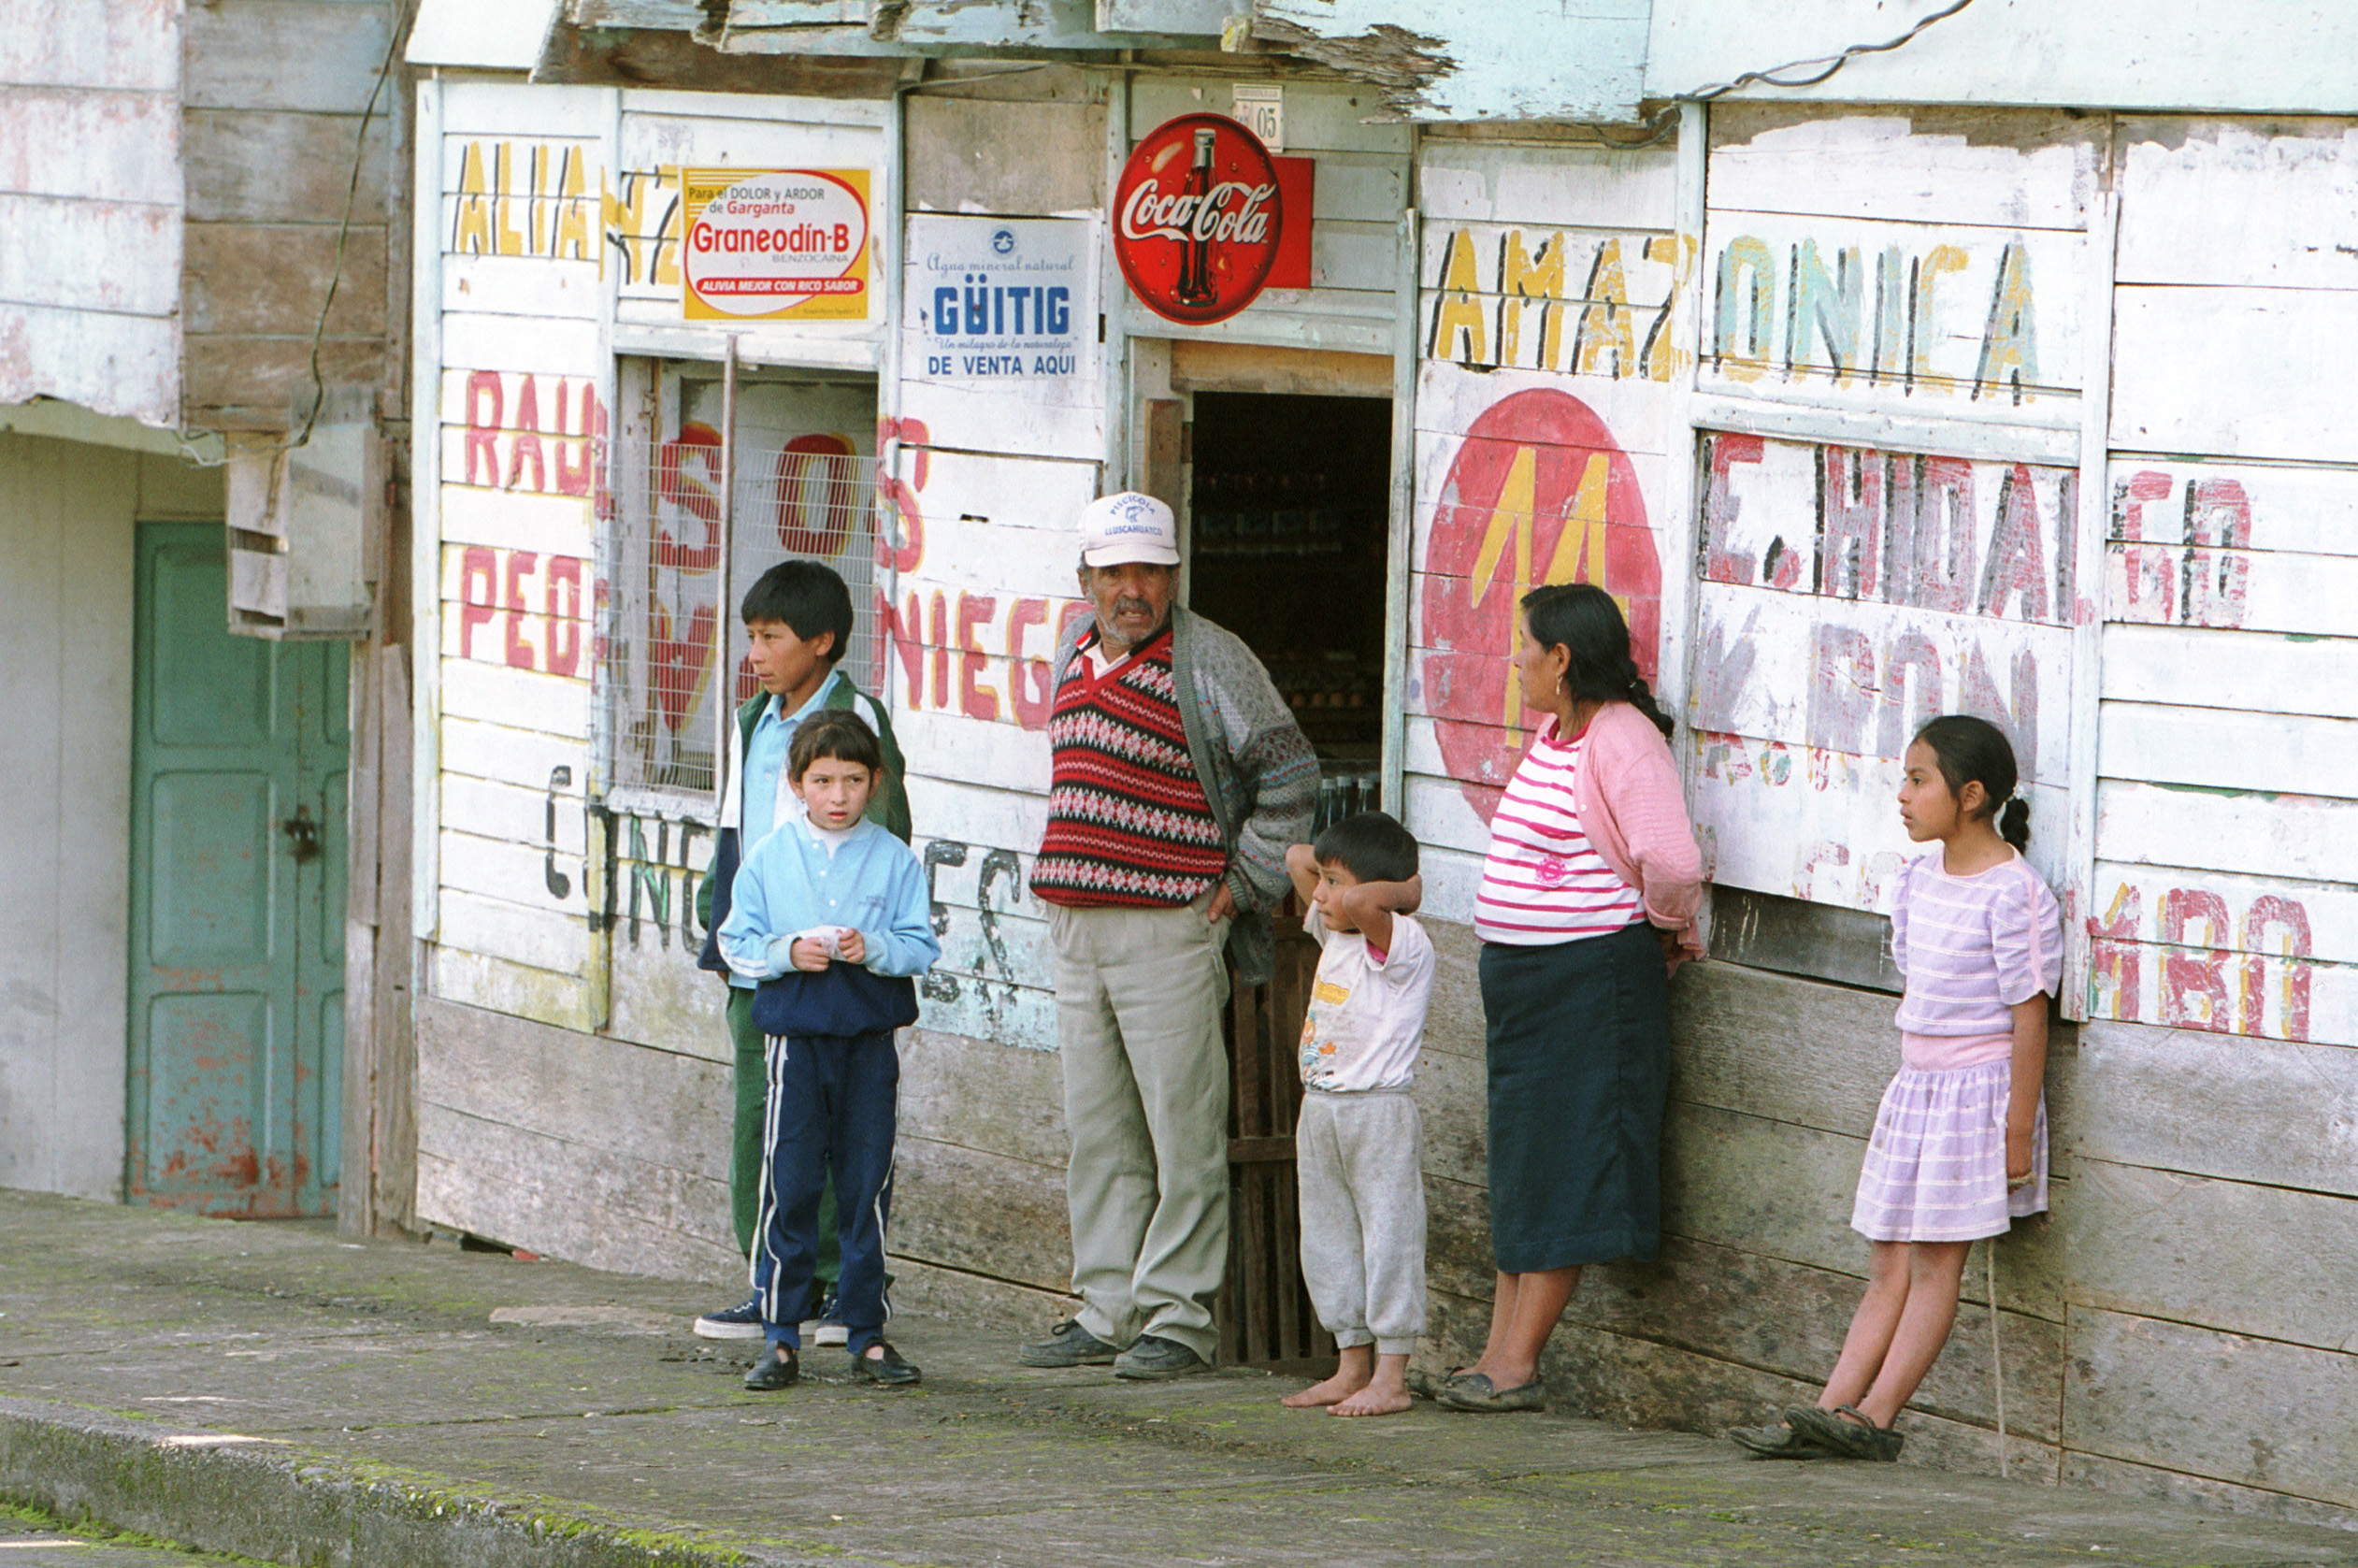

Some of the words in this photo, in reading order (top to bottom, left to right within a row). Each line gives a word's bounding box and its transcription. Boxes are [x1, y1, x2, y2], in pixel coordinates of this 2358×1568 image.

[689, 187, 713, 199] Para
[717, 187, 727, 199] el
[731, 188, 770, 199] DOLOR
[774, 191, 781, 202] y
[784, 188, 825, 199] ARDOR
[710, 202, 724, 213] de
[727, 201, 795, 217] Garganta
[1122, 179, 1276, 243] Coca-Cola
[694, 223, 849, 252] Graneodín-B
[772, 254, 848, 263] BENZOCAINA
[927, 253, 964, 278] Agua
[970, 255, 1022, 270] mineral
[1026, 255, 1074, 270] natural
[701, 281, 736, 291] ALIVIA
[738, 281, 772, 291] MEJOR
[774, 281, 796, 291] CON
[798, 281, 822, 291] RICO
[824, 281, 857, 291] SABOR
[935, 273, 1069, 335] GÜITIG
[1428, 227, 2042, 405] AMAZONICA
[957, 338, 995, 352] milagro
[998, 338, 1010, 349] de
[1011, 338, 1022, 349] la
[928, 356, 952, 374] DE
[964, 356, 1023, 374] VENTA
[1034, 355, 1075, 374] AQUI
